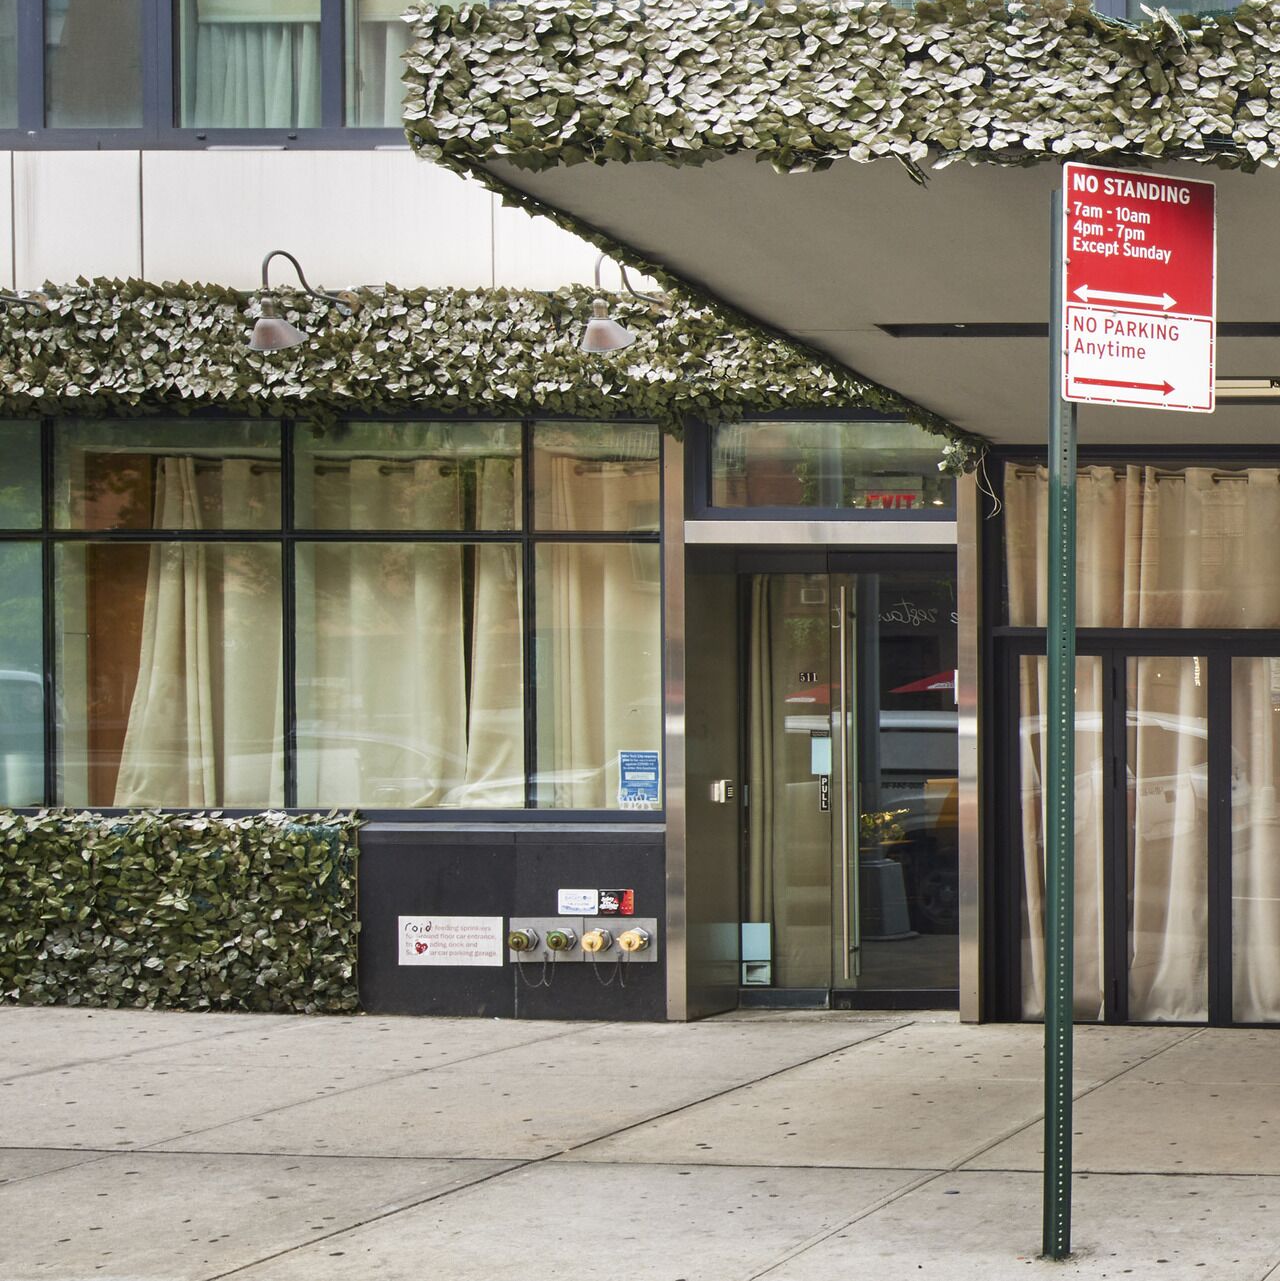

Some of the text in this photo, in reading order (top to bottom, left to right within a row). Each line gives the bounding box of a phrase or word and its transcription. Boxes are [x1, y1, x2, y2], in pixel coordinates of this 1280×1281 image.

[1073, 173, 1191, 205] NO STANDING
[1073, 202, 1101, 219] 7am
[1116, 208, 1150, 224] 10am
[1073, 220, 1103, 236] 4pm
[1116, 224, 1145, 241] 7pm
[1072, 237, 1172, 265] Except Sunday
[1073, 316, 1180, 342] NO PARKING
[1074, 337, 1146, 360] Anytime
[799, 672, 818, 683] 511
